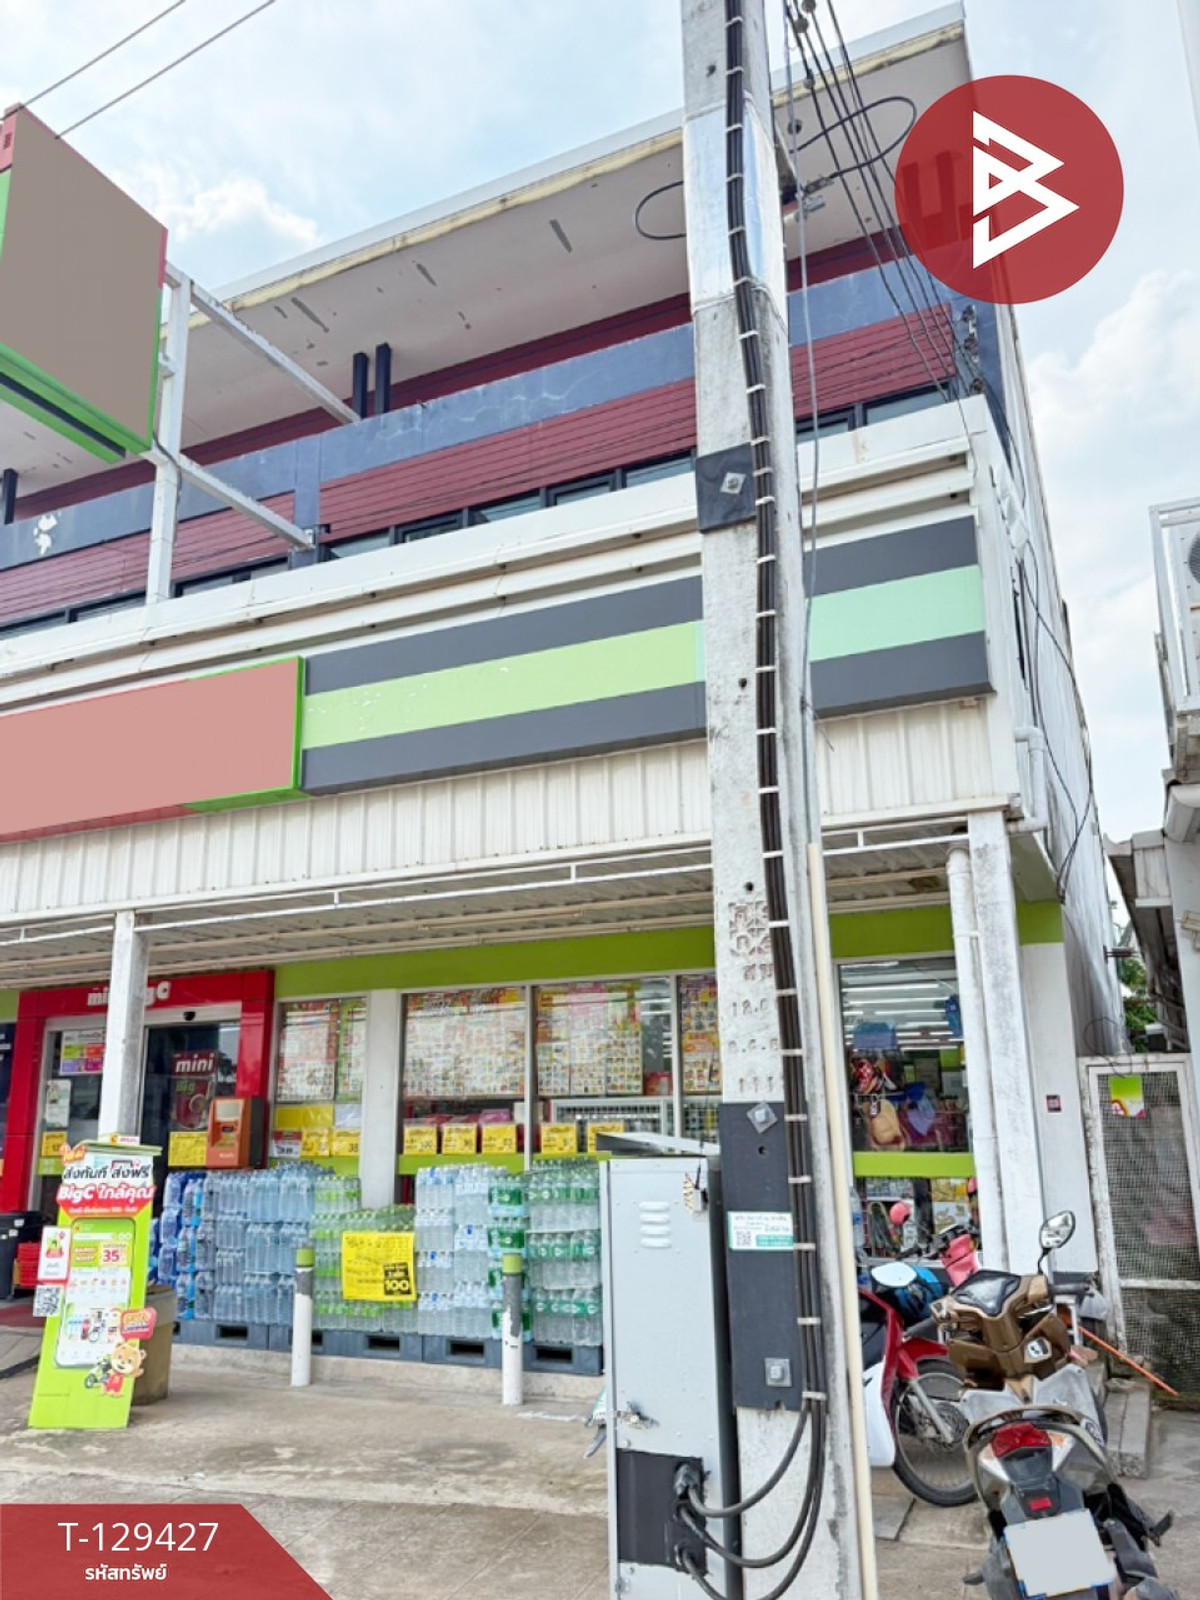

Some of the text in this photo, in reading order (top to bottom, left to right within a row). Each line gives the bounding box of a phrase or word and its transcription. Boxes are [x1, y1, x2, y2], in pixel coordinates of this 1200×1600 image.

[175, 1053, 215, 1073] mini
[63, 1164, 151, 1180] ส่งทันที ส่งฟรี
[57, 1182, 155, 1204] BigC ใกล้คุณ
[102, 1248, 121, 1263] 35
[384, 1279, 409, 1291] 100
